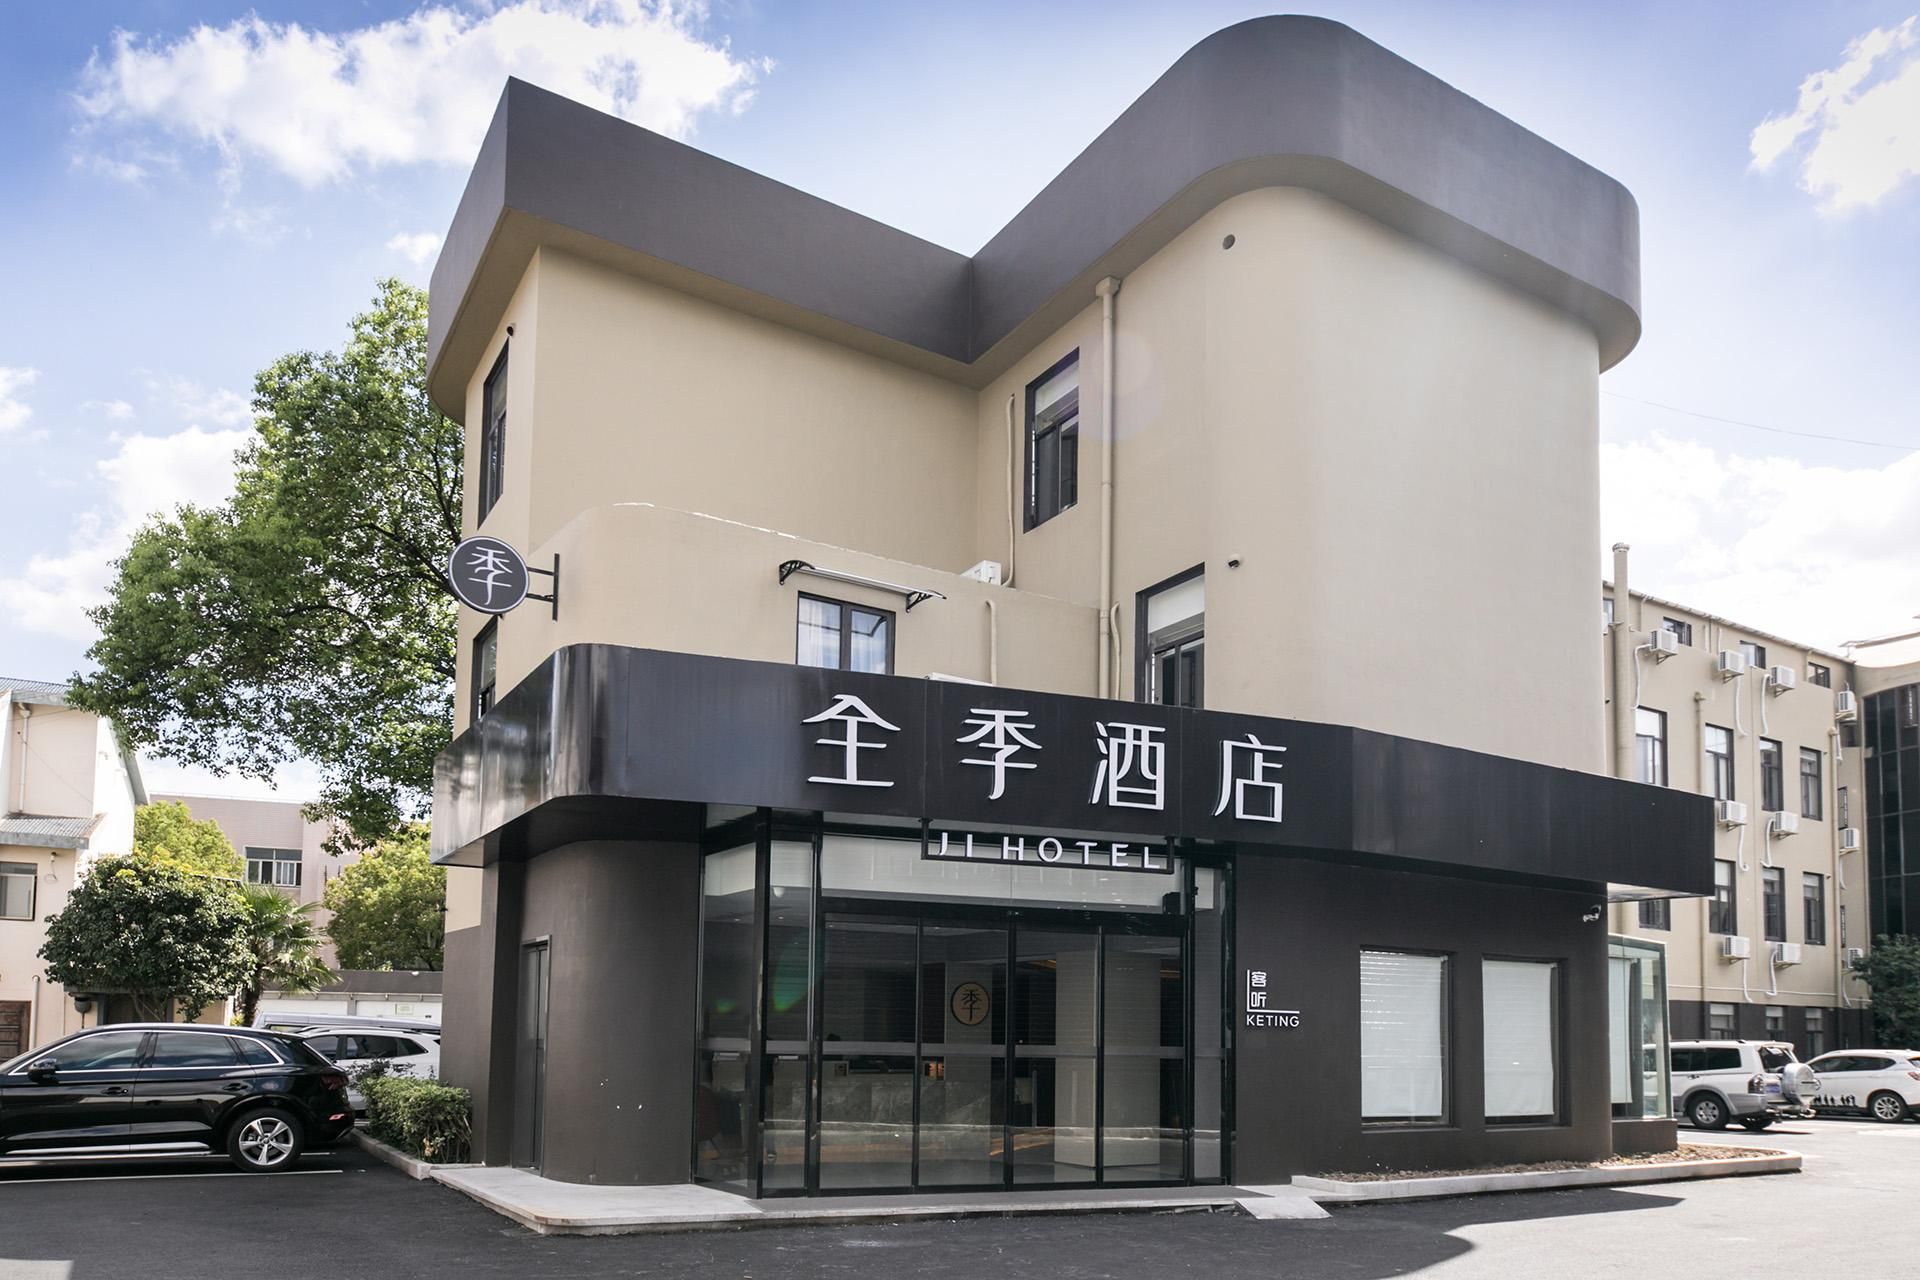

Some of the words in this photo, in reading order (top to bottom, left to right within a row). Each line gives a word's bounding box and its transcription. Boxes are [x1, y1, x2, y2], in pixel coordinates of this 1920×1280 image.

[465, 546, 514, 606] 季
[800, 693, 1288, 824] 全季酒店
[938, 831, 974, 858] JI
[1002, 836, 1161, 870] HOTEL
[959, 988, 983, 1023] 季
[1245, 1013, 1301, 1028] KETING
